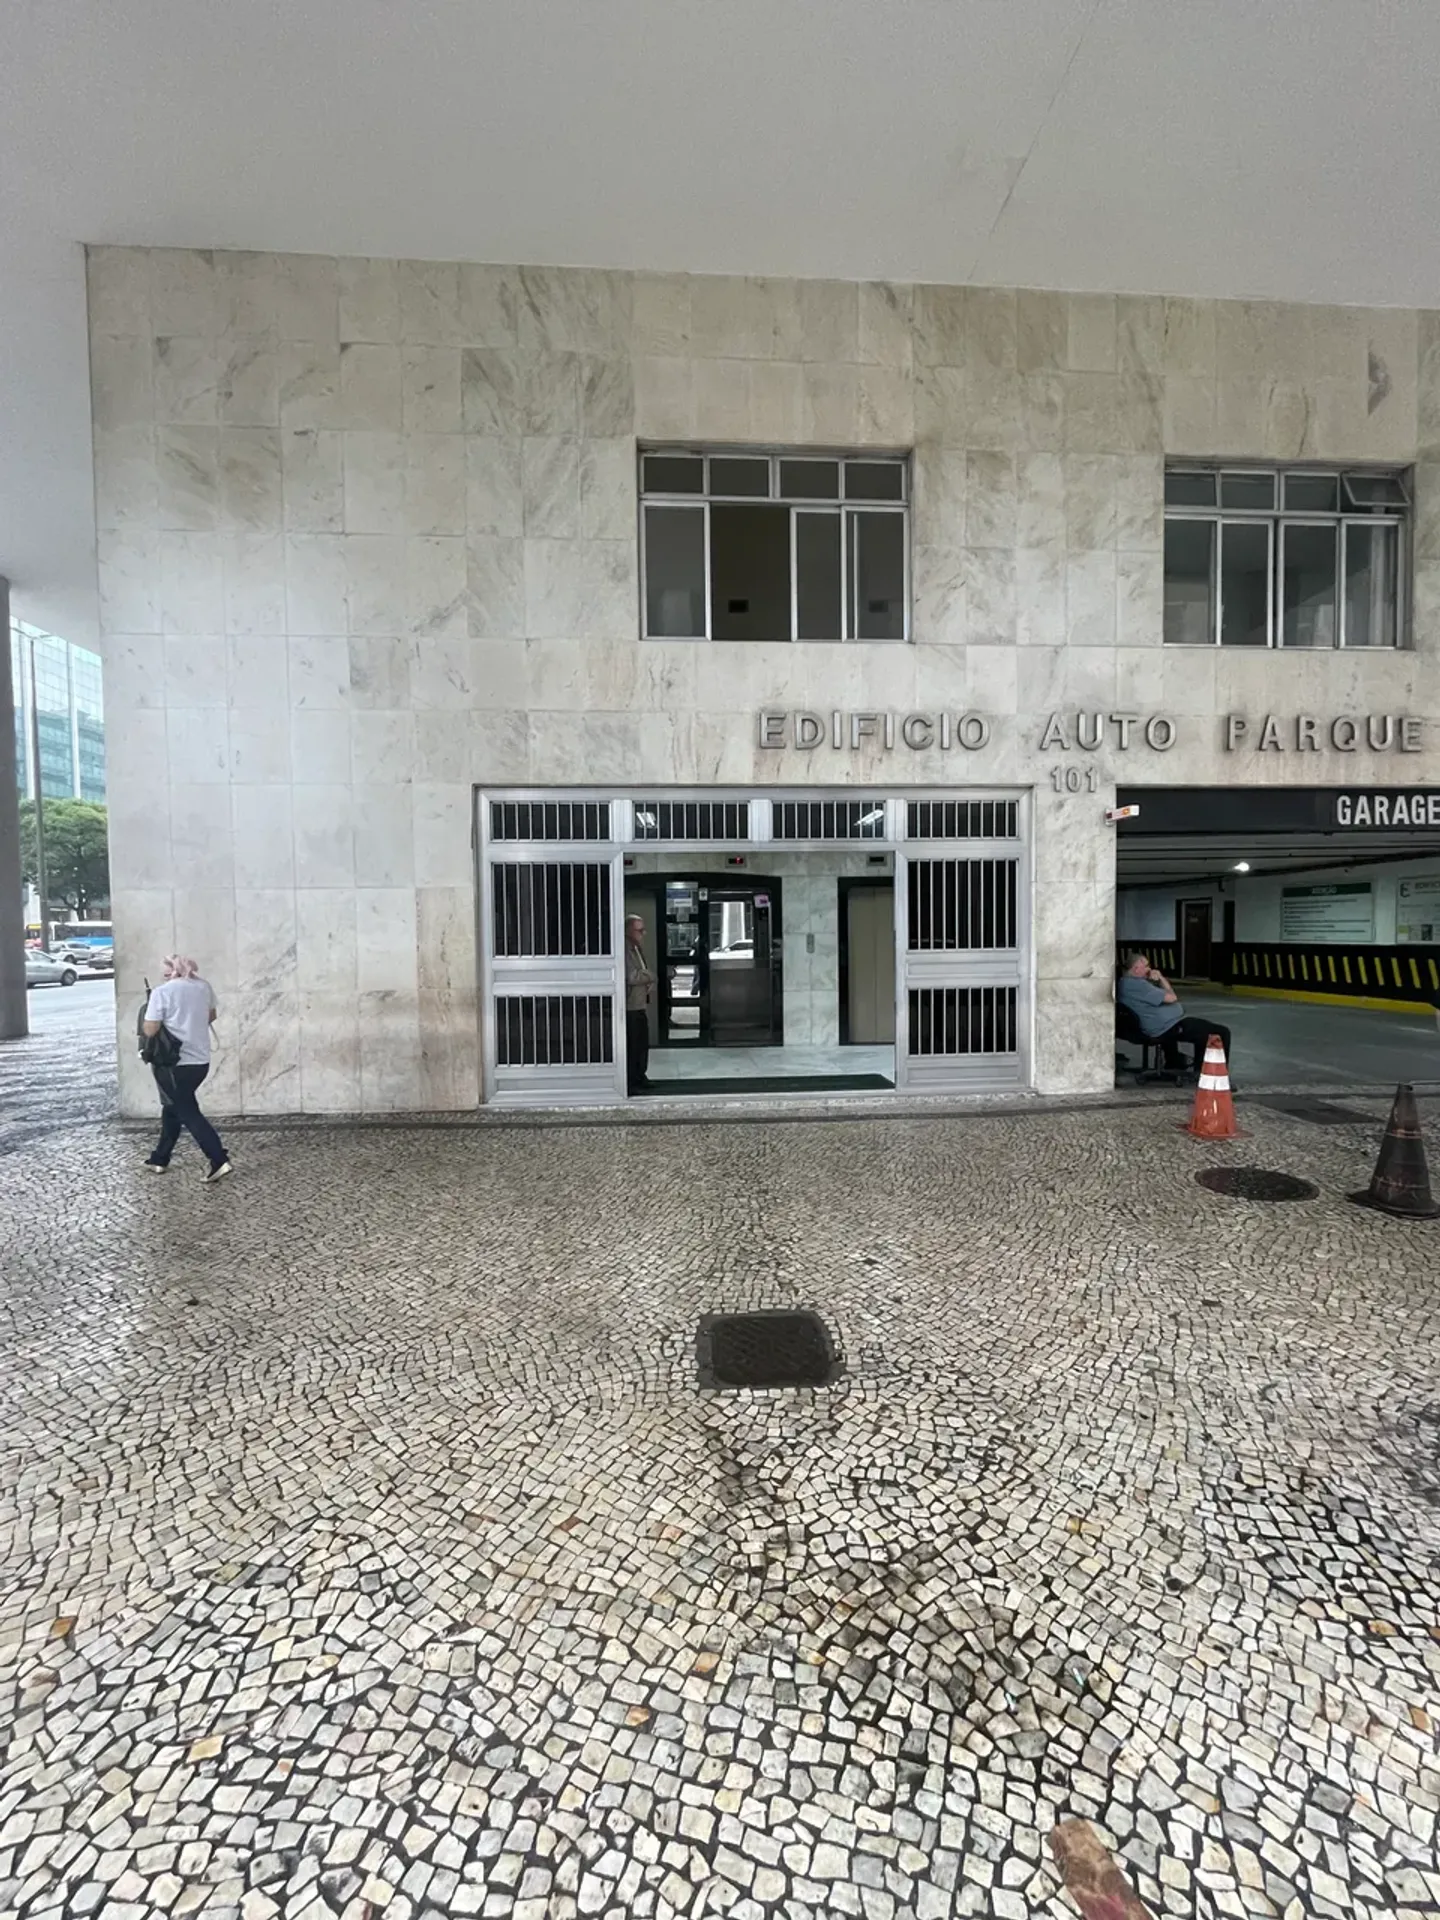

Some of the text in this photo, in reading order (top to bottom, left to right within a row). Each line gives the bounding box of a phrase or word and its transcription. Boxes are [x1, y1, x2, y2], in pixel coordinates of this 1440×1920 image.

[758, 711, 1424, 753] EDIFICIO AUTO PARQUE
[1050, 766, 1097, 793] 101
[1337, 795, 1440, 825] GARAGE
